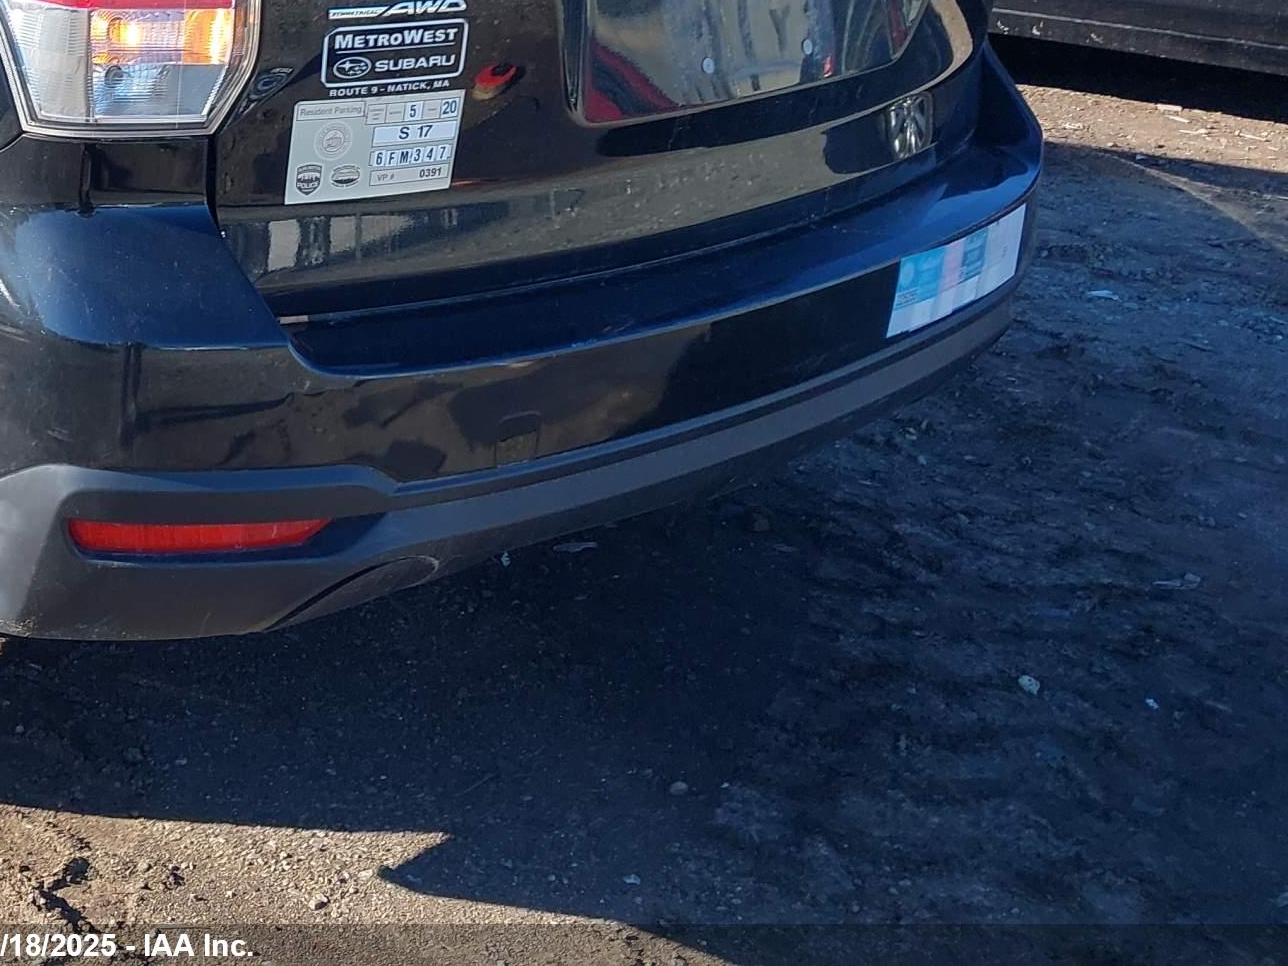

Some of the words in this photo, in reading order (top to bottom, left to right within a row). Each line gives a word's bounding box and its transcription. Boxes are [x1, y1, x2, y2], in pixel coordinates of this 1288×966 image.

[374, 54, 456, 72] SUBARU
[329, 86, 368, 97] ROUTE
[370, 86, 378, 94] 9
[386, 81, 431, 93] NATICK,
[432, 80, 450, 88] MA
[409, 104, 417, 118] 5
[442, 100, 457, 115] 20
[398, 126, 410, 140] S
[417, 125, 433, 138] 17
[377, 173, 389, 181] VP
[419, 166, 442, 179] 0391
